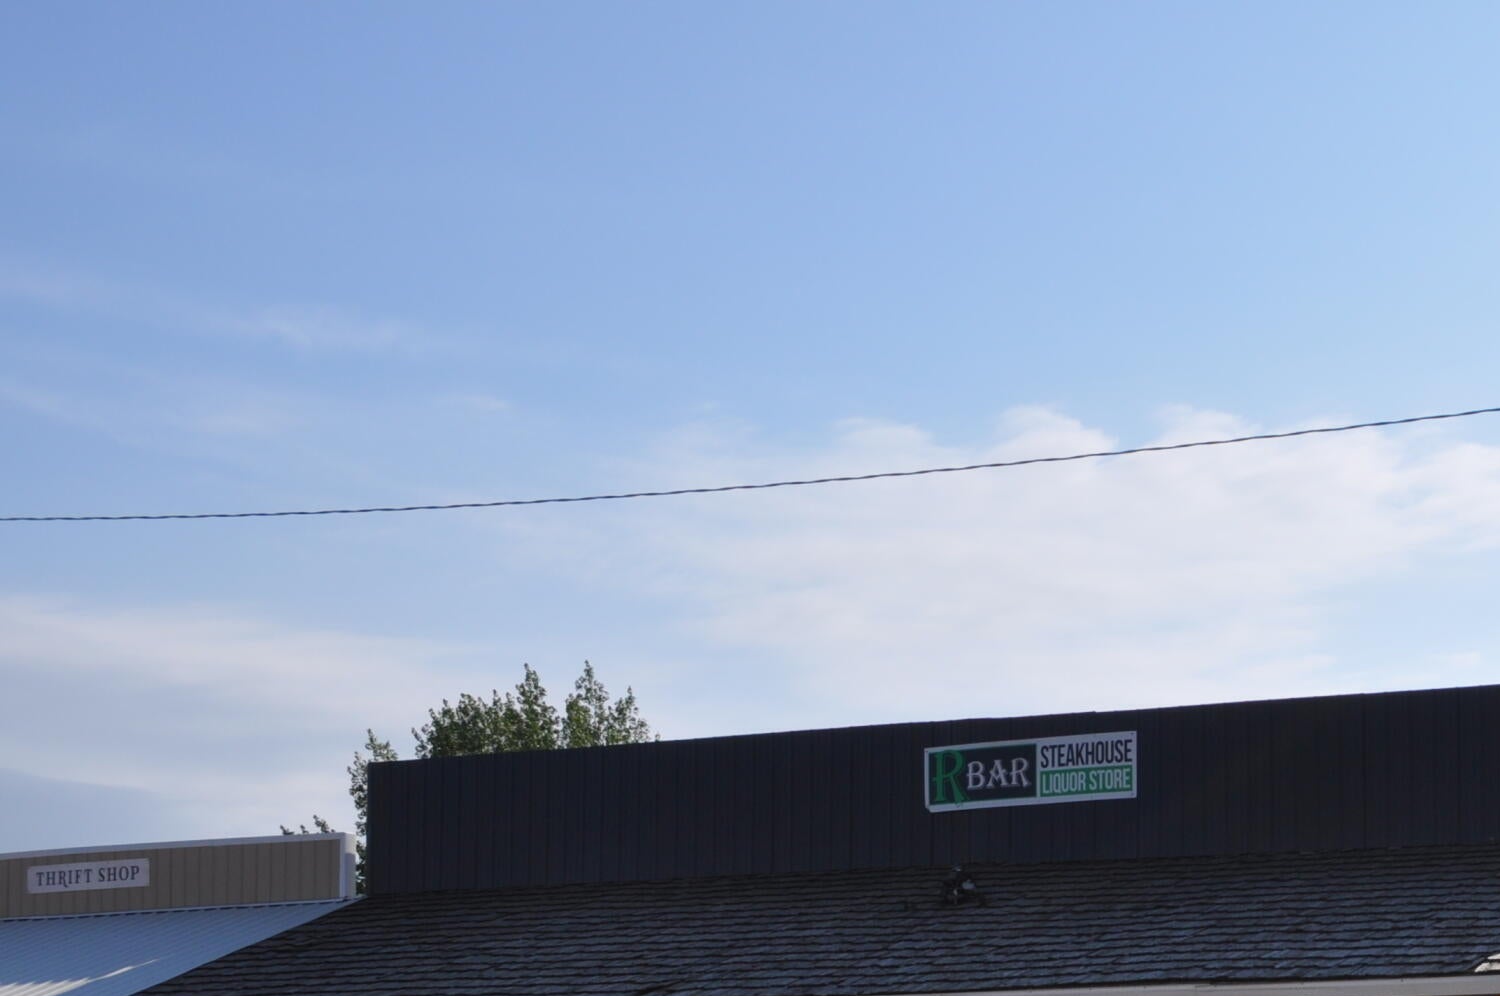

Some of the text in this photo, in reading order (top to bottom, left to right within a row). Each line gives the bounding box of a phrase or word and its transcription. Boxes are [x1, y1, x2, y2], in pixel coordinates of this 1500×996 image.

[1040, 739, 1133, 768] STEAKHOUSE
[932, 749, 1031, 805] R BAR
[1042, 768, 1131, 794] LIQUOR STORE
[36, 865, 140, 888] THRIFT SHOP
